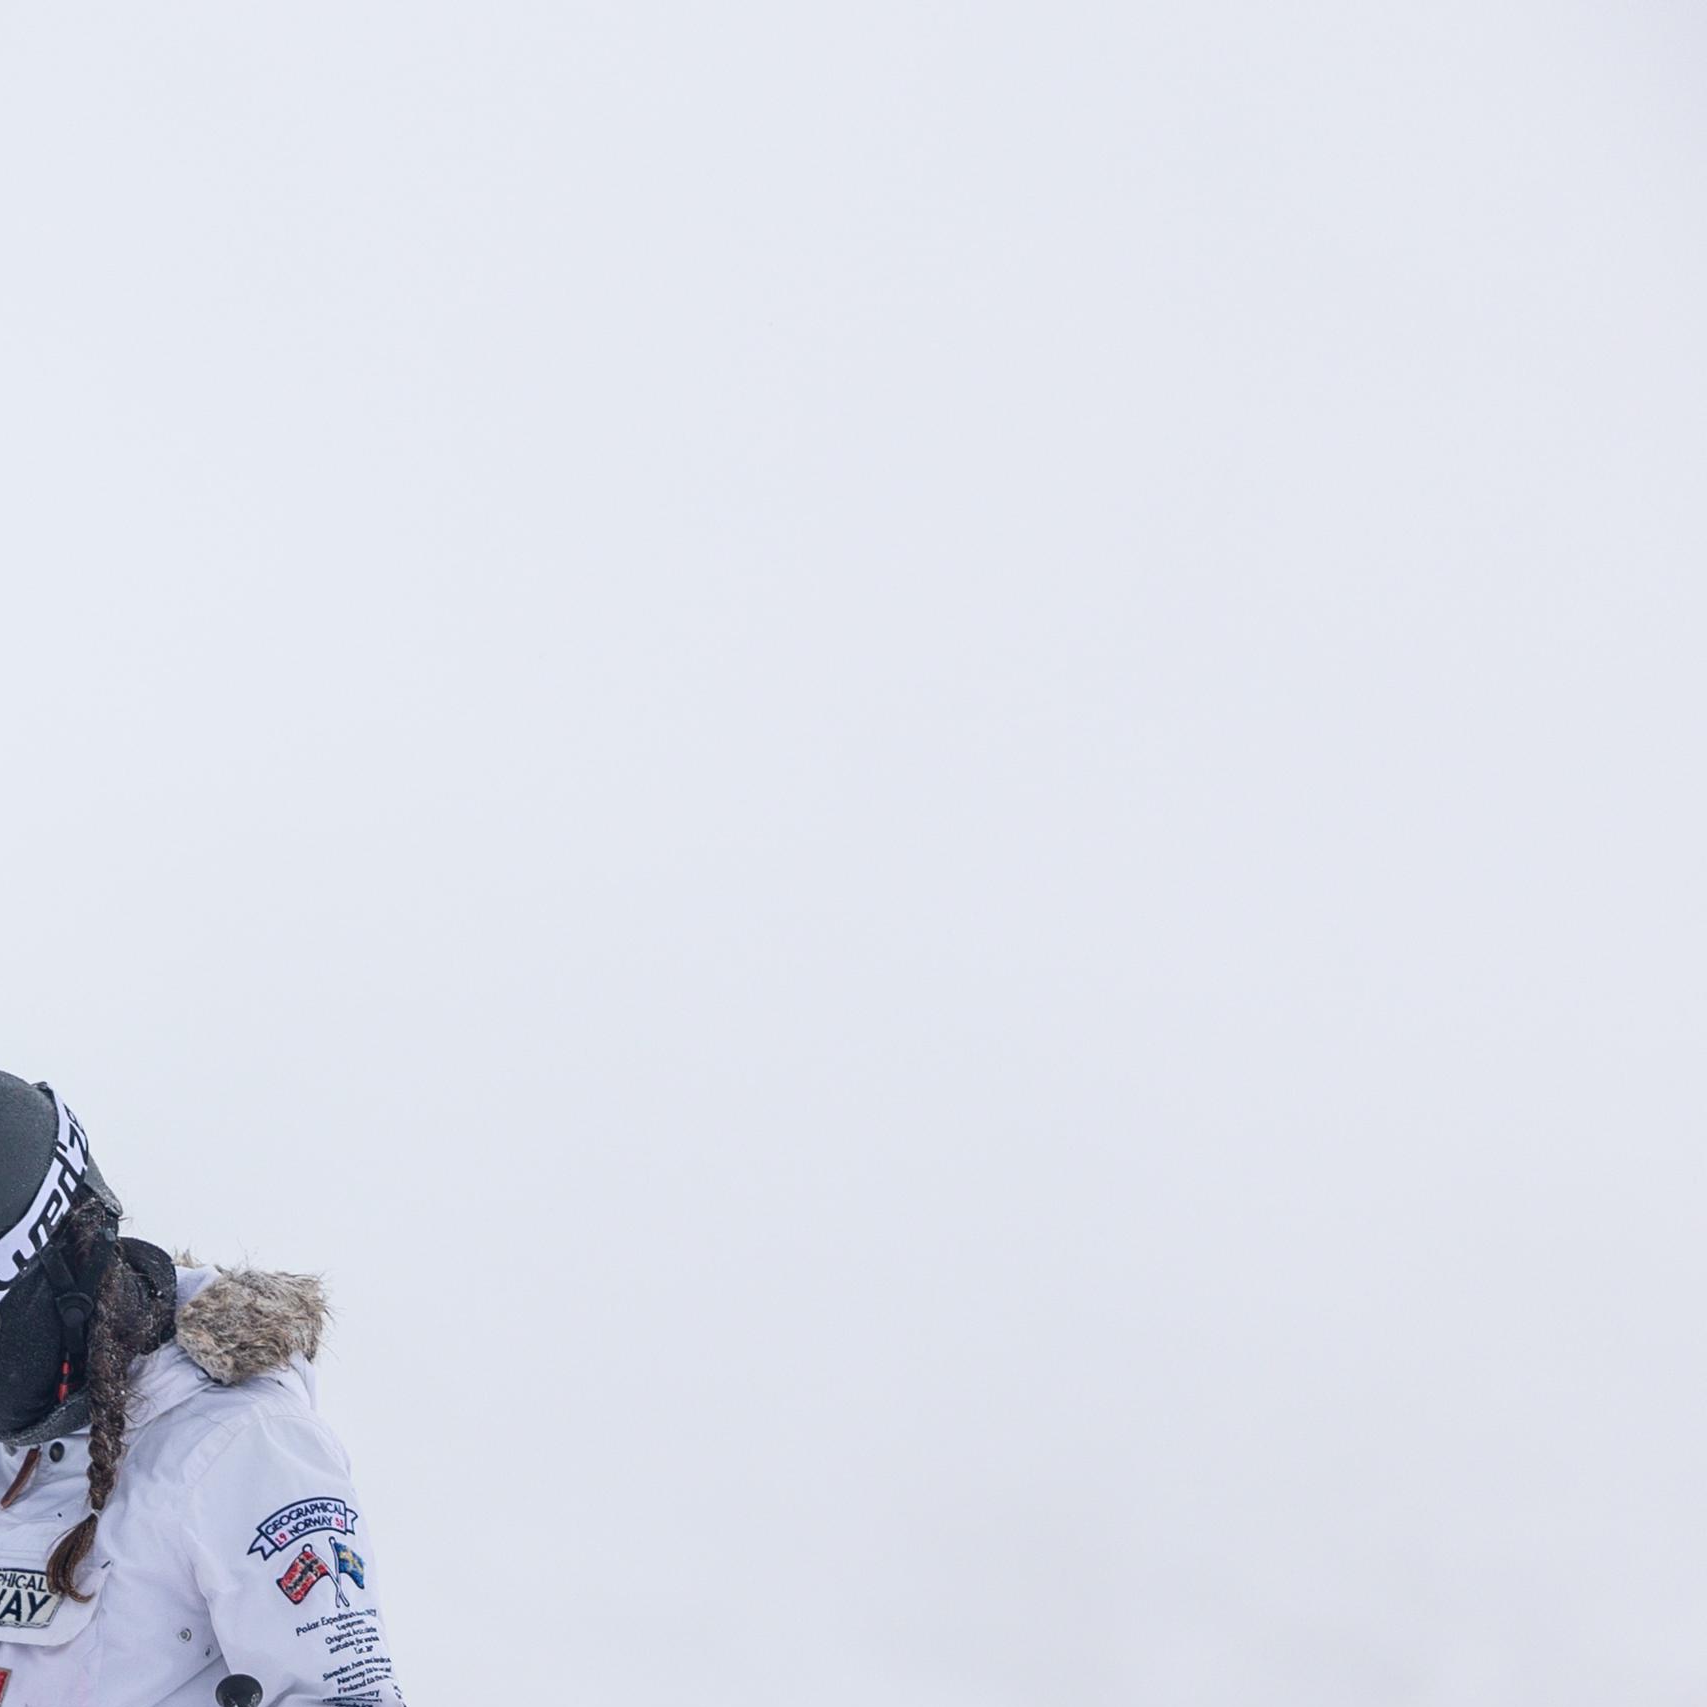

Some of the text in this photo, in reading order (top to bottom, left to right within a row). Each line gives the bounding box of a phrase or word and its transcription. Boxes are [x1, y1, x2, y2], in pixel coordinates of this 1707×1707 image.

[265, 1502, 344, 1535] GEOGRAPHICAL
[288, 1516, 333, 1536] NORWAY
[296, 1621, 320, 1636] Polar
[323, 1664, 351, 1681] Sweden
